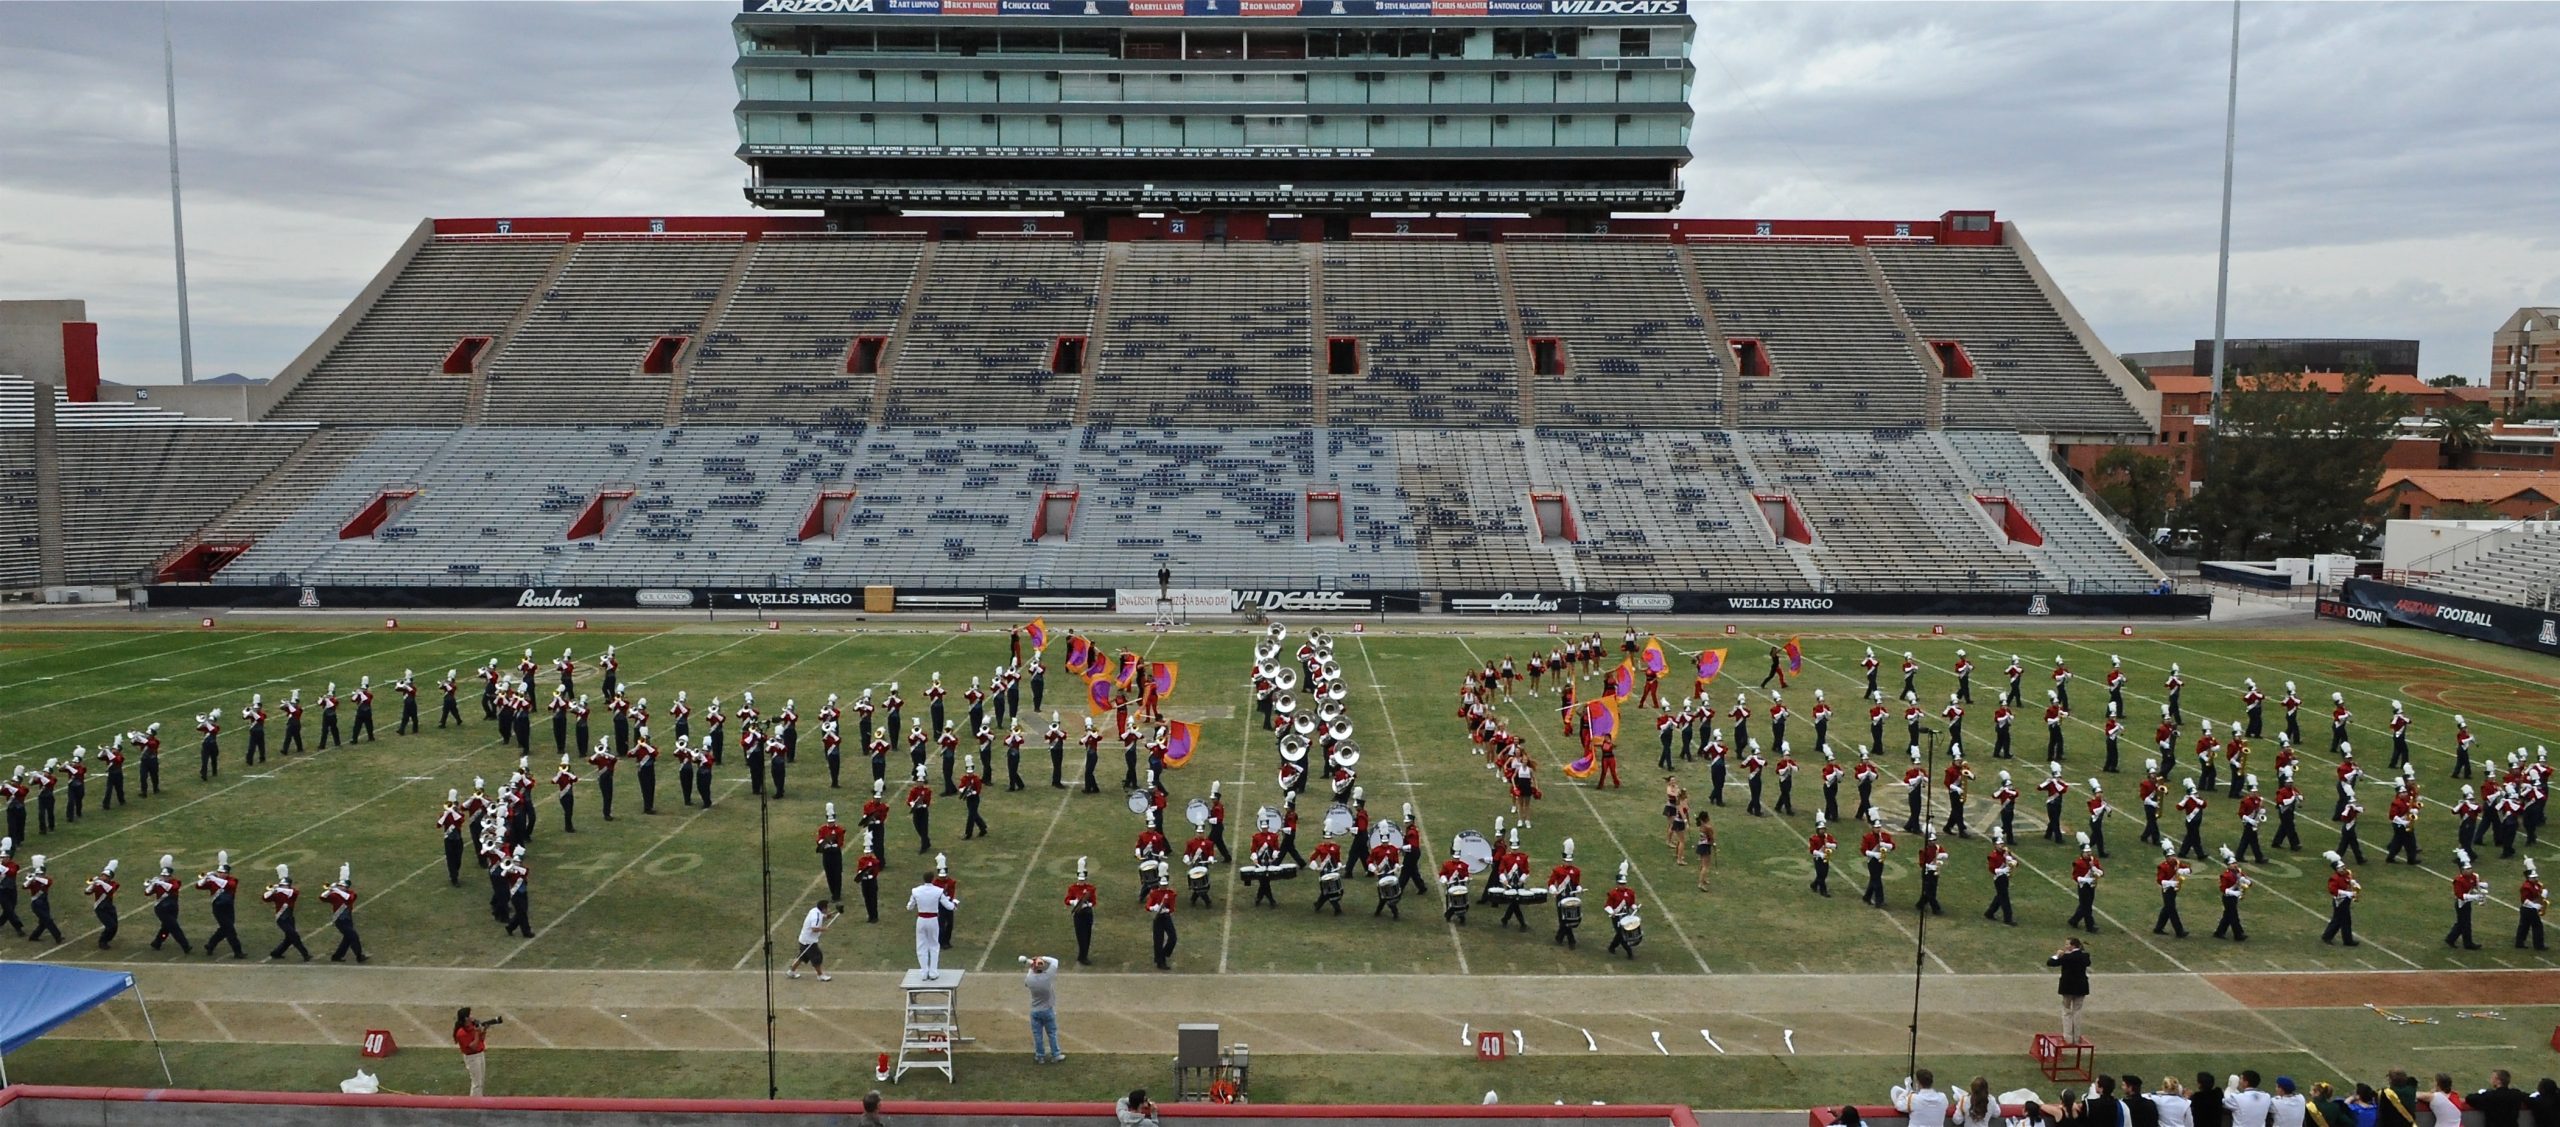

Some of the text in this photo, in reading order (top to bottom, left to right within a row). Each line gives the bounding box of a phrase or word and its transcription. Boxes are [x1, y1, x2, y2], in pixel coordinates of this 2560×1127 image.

[756, 0, 874, 12] ARIZONA
[1493, 2, 1520, 10] ANTOINE
[1521, 2, 1543, 10] CASON
[1551, 0, 1680, 14] WILDCATS
[499, 225, 509, 234] 17
[652, 224, 663, 233] 18
[826, 224, 837, 232] 19
[1023, 224, 1036, 233] 20
[1172, 223, 1184, 232] 21
[1396, 224, 1409, 234] 22
[1757, 227, 1770, 236] 24
[1896, 228, 1909, 238] 25
[137, 390, 147, 398] 16
[517, 589, 582, 607] Bashas'
[747, 593, 852, 604] WELLS FARGO
[1195, 596, 1214, 606] BAND
[1215, 596, 1229, 606] DAY
[1728, 598, 1833, 609] WELLS FARGO
[2347, 607, 2381, 625] DOWN
[2436, 605, 2492, 627] FOOTBALL
[364, 1033, 384, 1054] 40
[1481, 1036, 1500, 1056] 40
